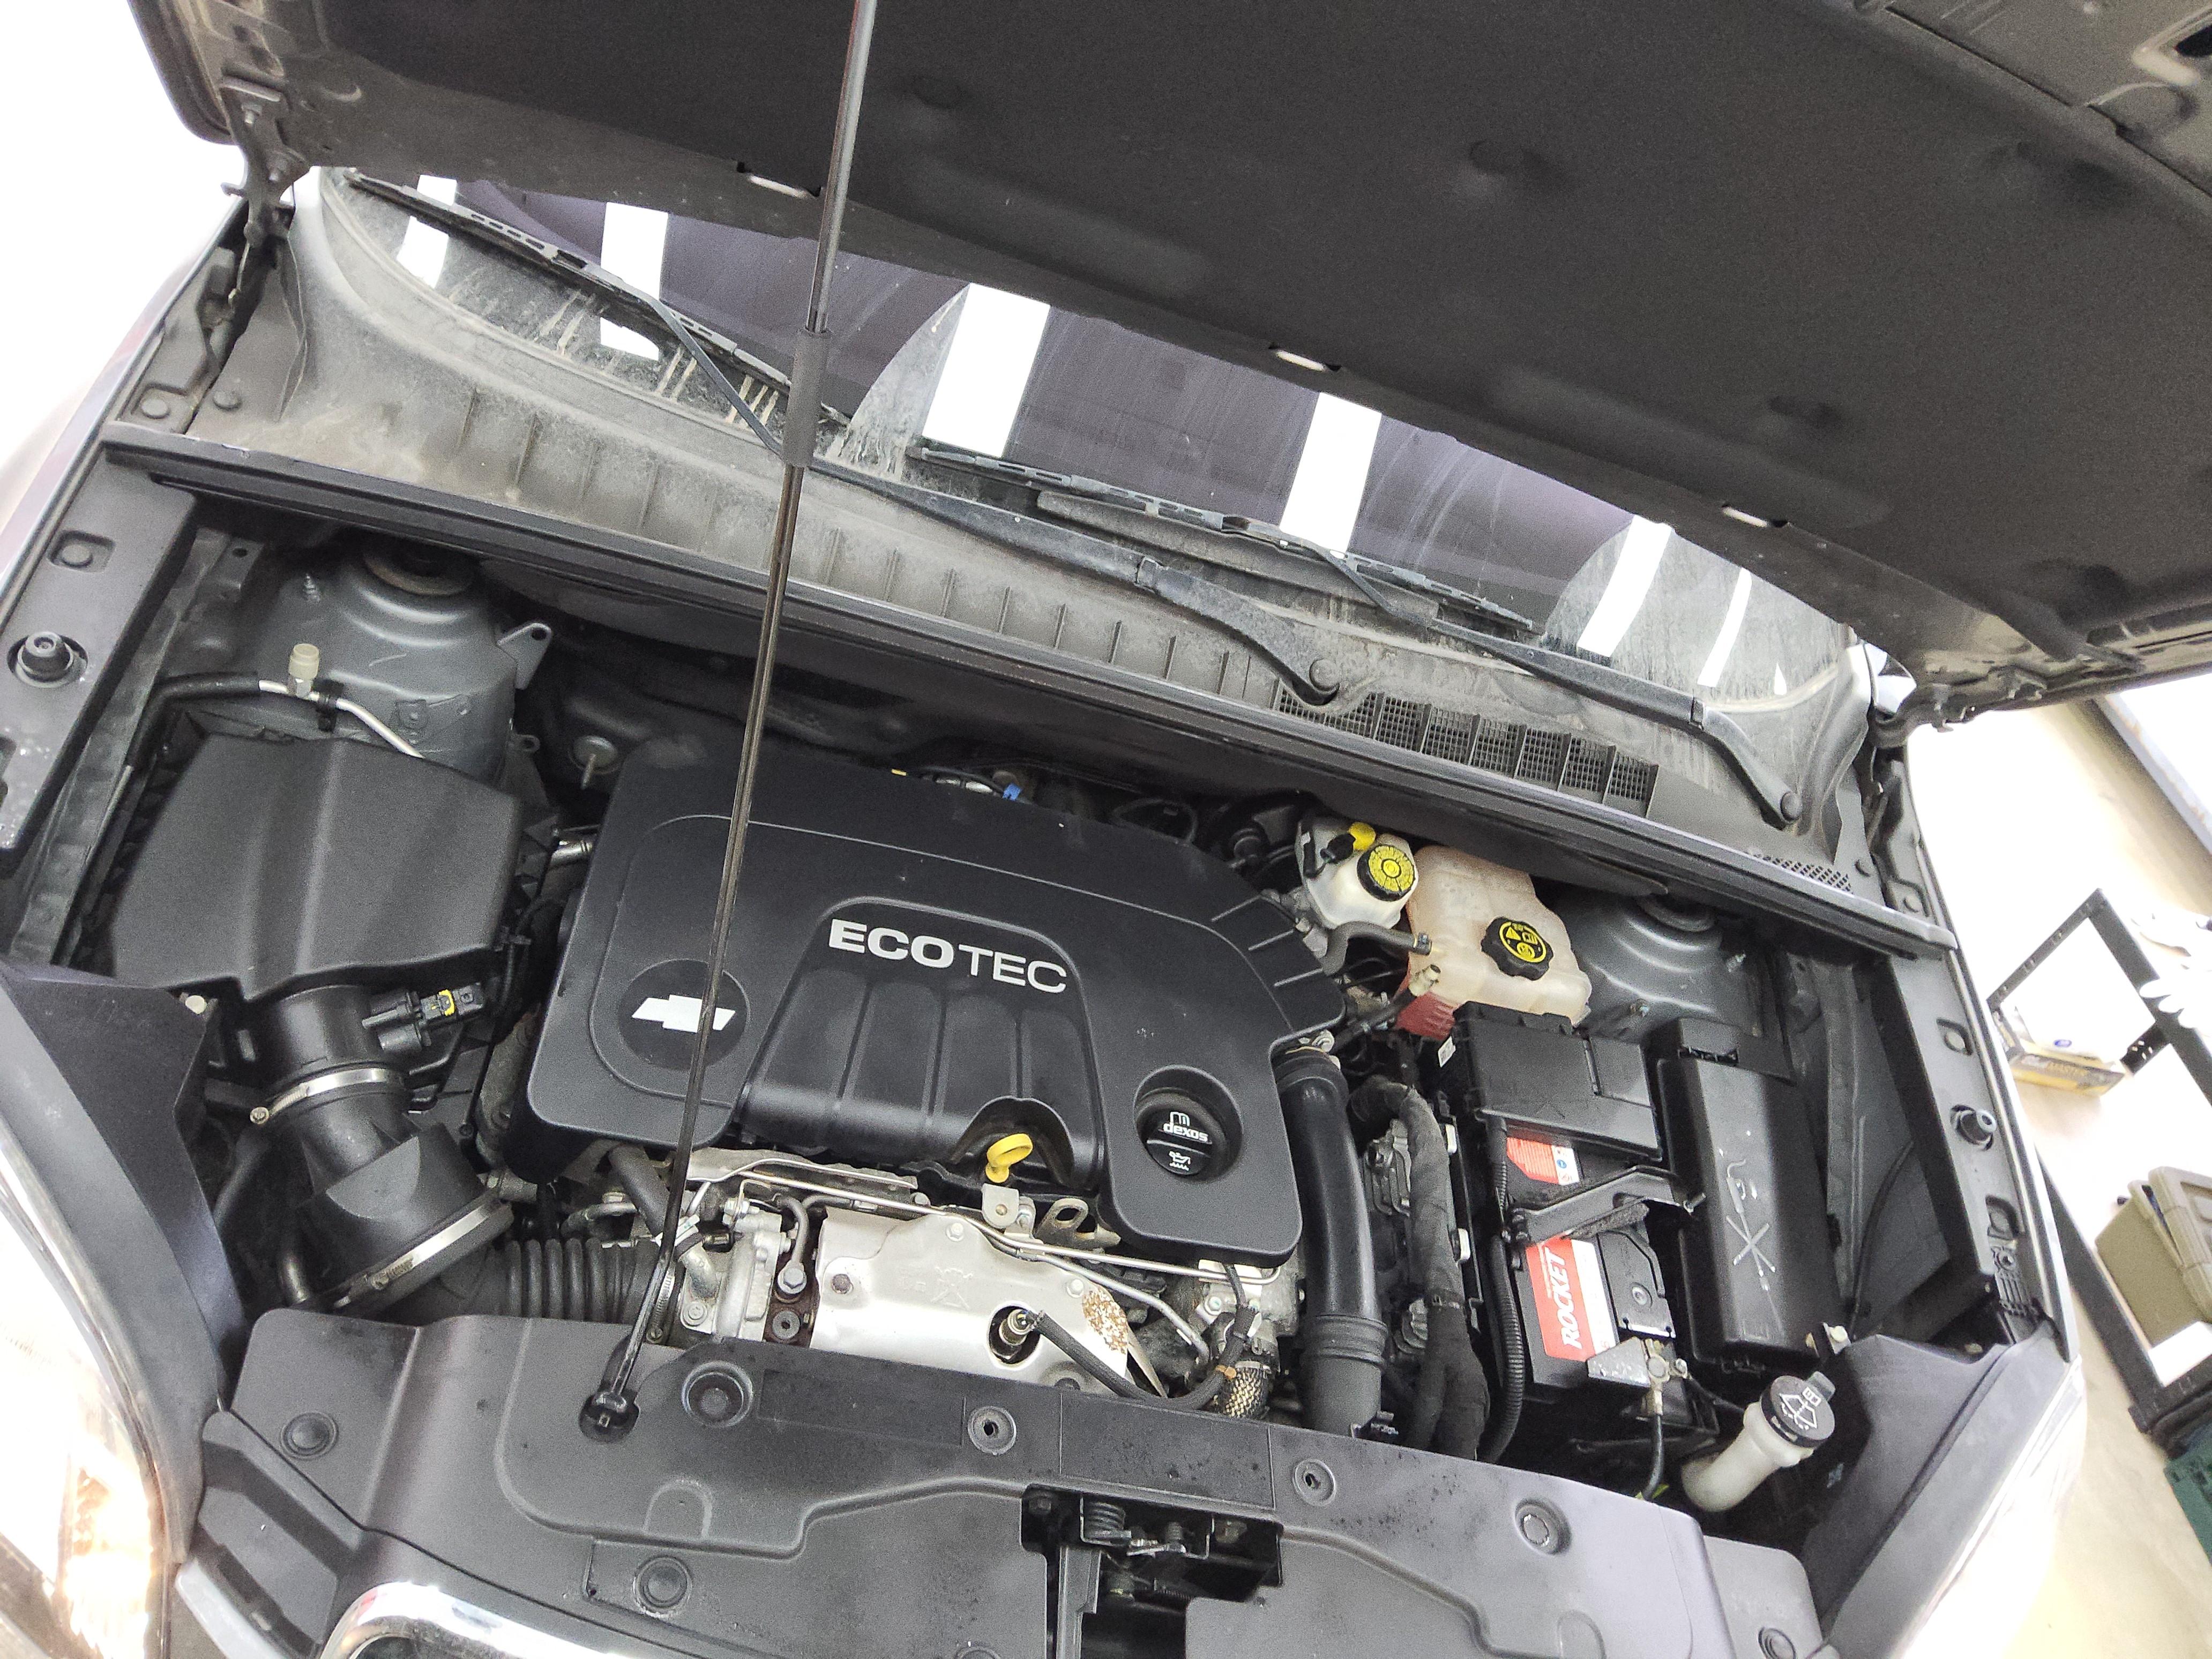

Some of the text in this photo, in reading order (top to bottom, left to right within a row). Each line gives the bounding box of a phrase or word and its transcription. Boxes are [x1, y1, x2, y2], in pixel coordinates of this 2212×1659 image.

[828, 918, 1067, 993] ECOTEC
[1163, 1122, 1209, 1142] dexos
[1544, 1246, 1582, 1349] ROCKET
